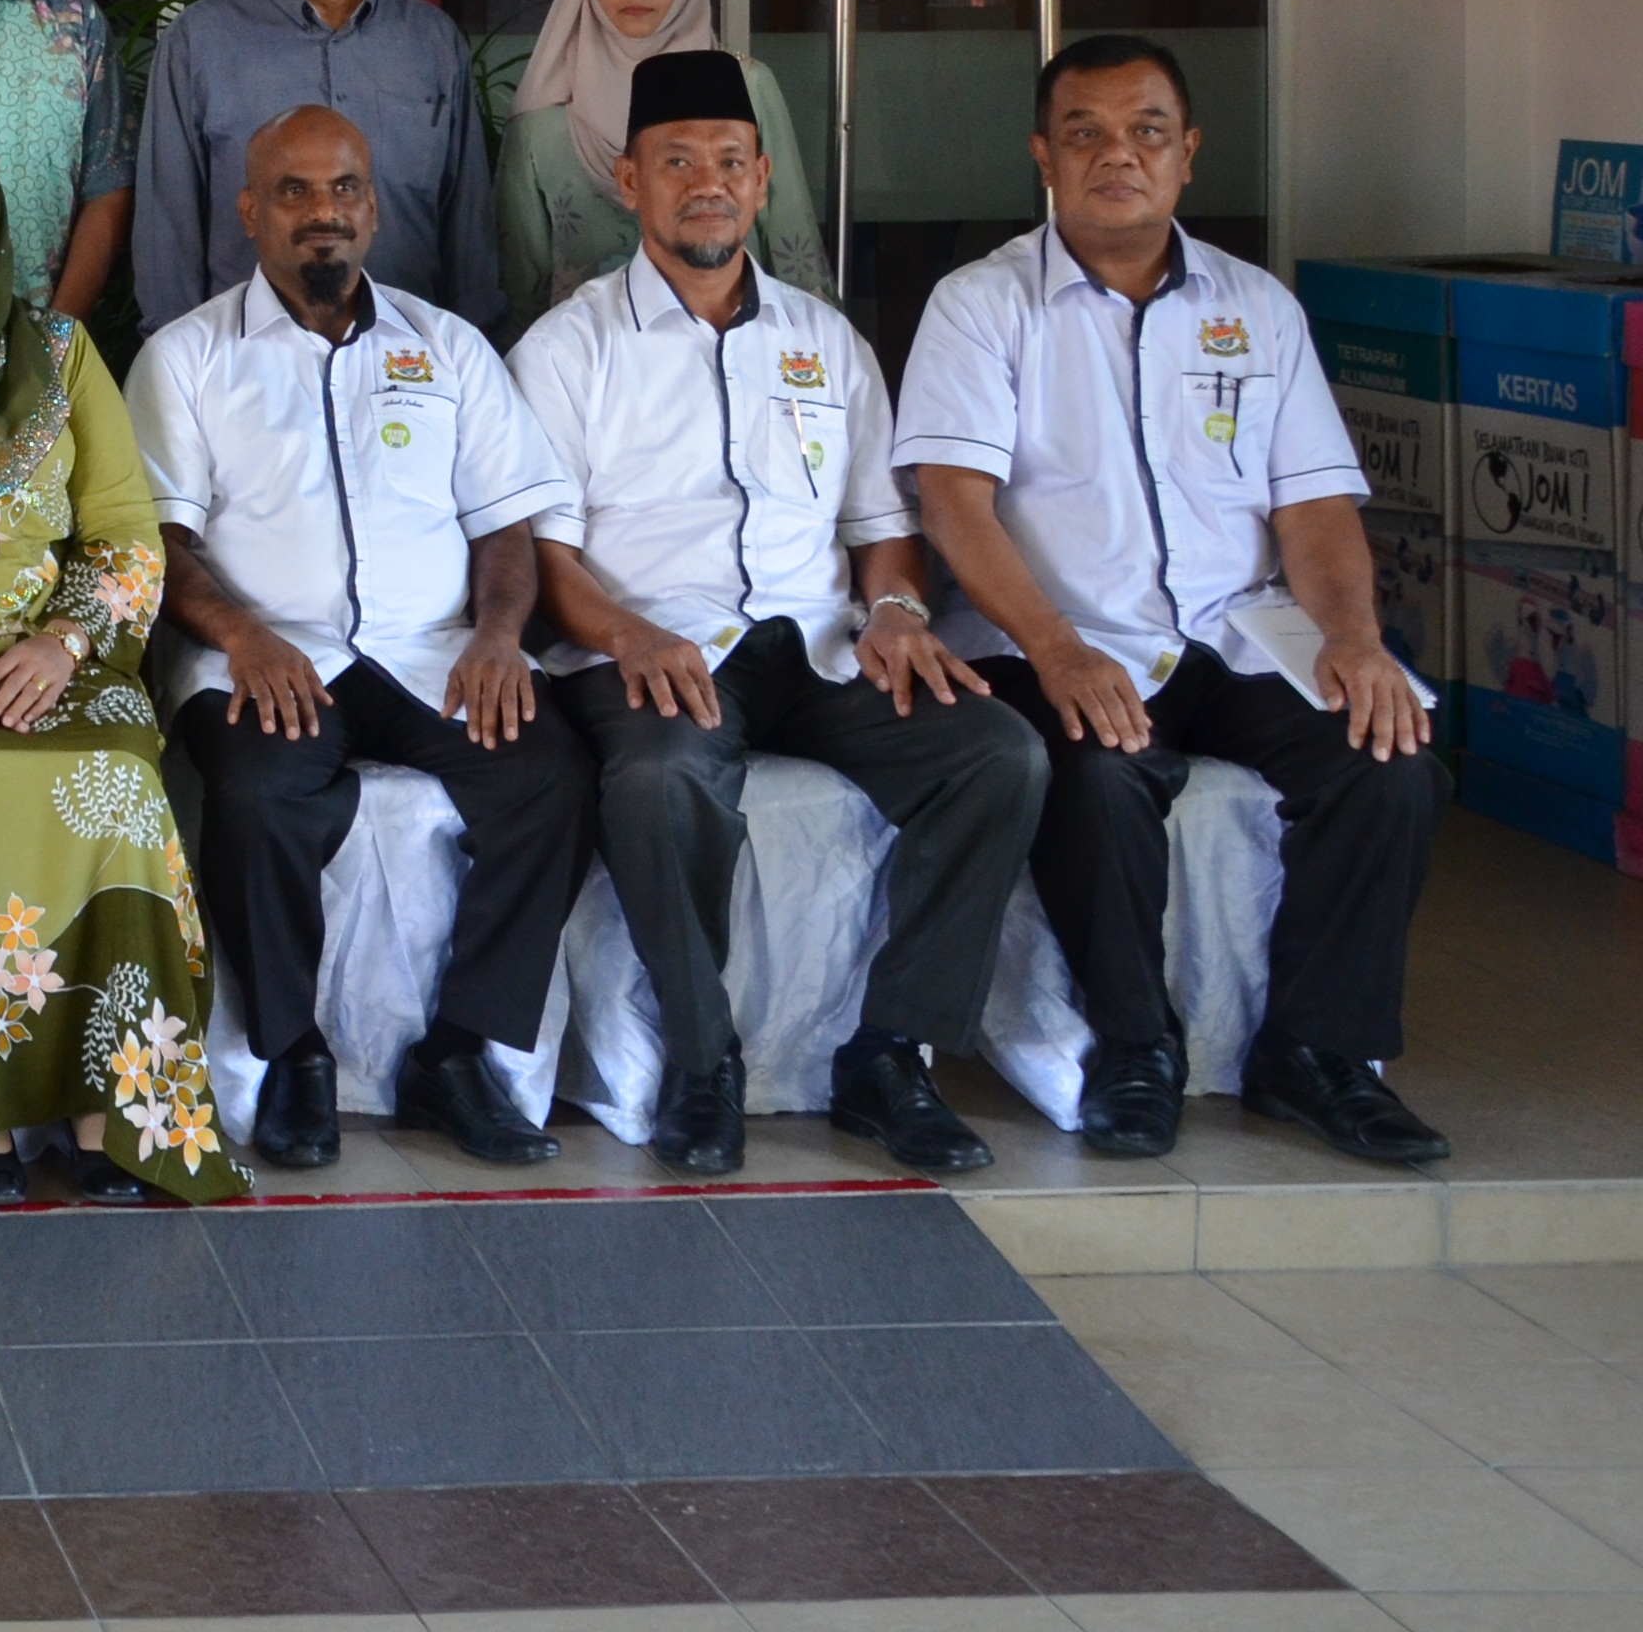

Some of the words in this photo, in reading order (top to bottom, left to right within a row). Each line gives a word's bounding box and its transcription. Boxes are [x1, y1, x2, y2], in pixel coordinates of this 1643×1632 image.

[1562, 158, 1627, 198] JOM
[1337, 343, 1397, 368] TETRAPAK
[1497, 372, 1579, 412] KERTAS
[1523, 463, 1571, 517] JOM
